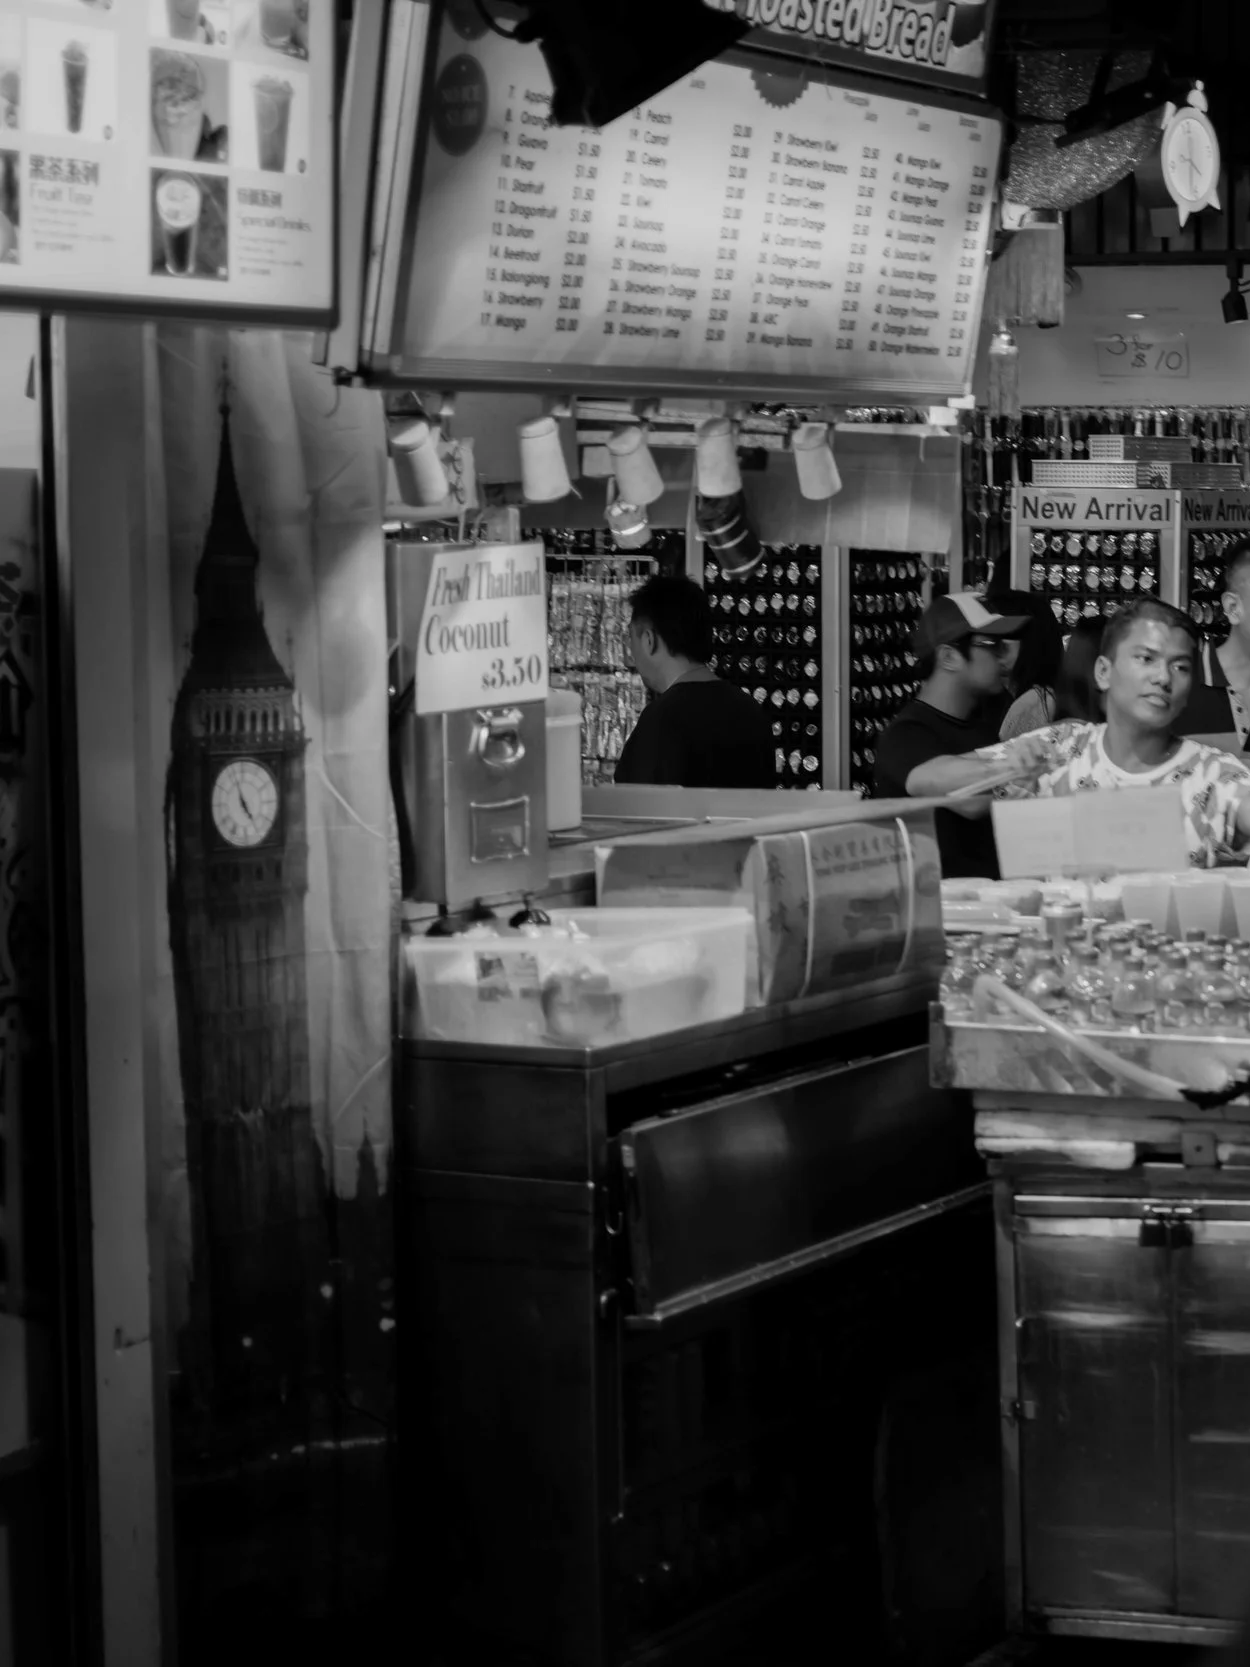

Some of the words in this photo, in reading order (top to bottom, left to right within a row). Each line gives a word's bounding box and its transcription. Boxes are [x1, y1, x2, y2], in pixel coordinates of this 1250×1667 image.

[866, 0, 957, 66] Bread
[519, 110, 555, 130] Orang
[1105, 333, 1128, 356] 3
[1022, 496, 1076, 520] New
[1085, 496, 1171, 522] Arrival
[1184, 497, 1213, 521] New
[431, 563, 469, 607] Fresh
[476, 556, 542, 601] Thailand
[425, 611, 510, 657] Coconut
[481, 654, 542, 691] $3.50
